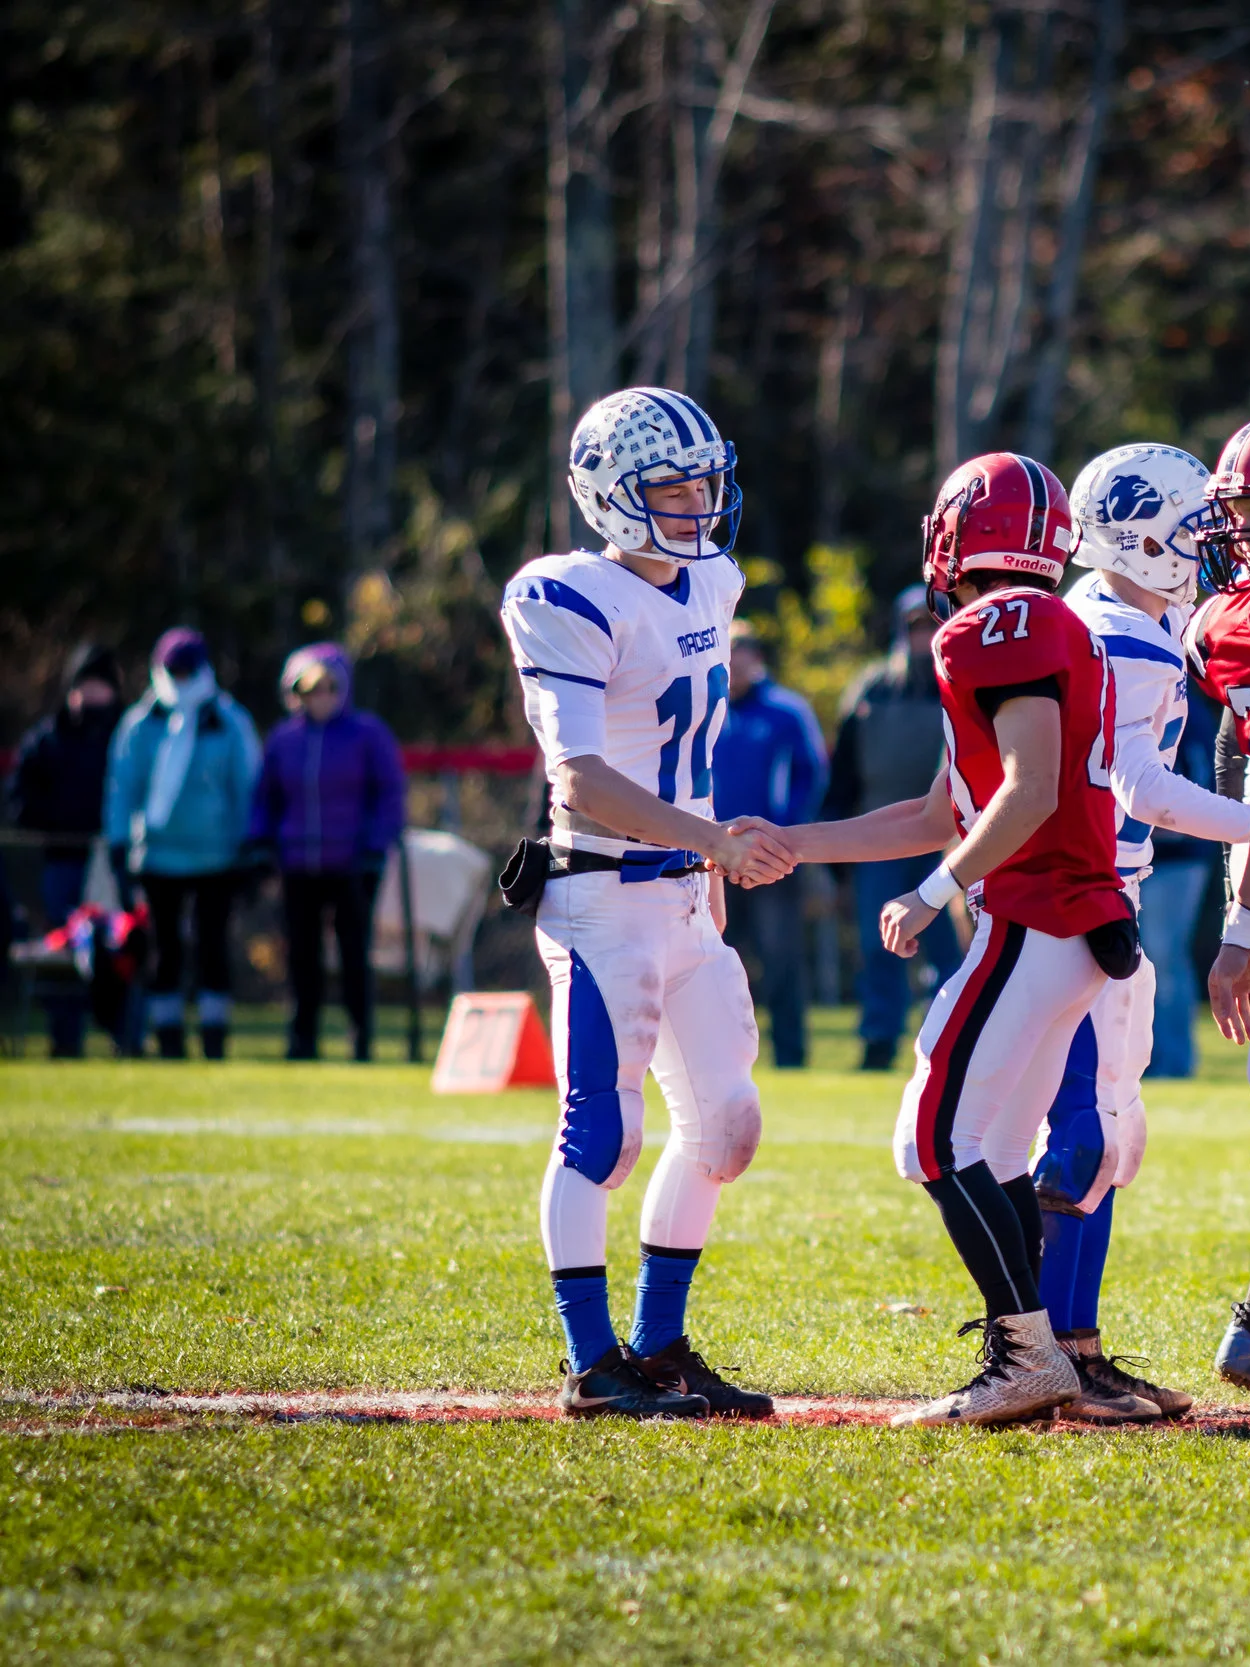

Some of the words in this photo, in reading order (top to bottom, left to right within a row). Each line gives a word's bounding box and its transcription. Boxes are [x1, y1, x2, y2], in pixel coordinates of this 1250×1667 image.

[677, 626, 719, 659] MADISON
[977, 599, 1030, 647] 27
[655, 662, 730, 805] 10
